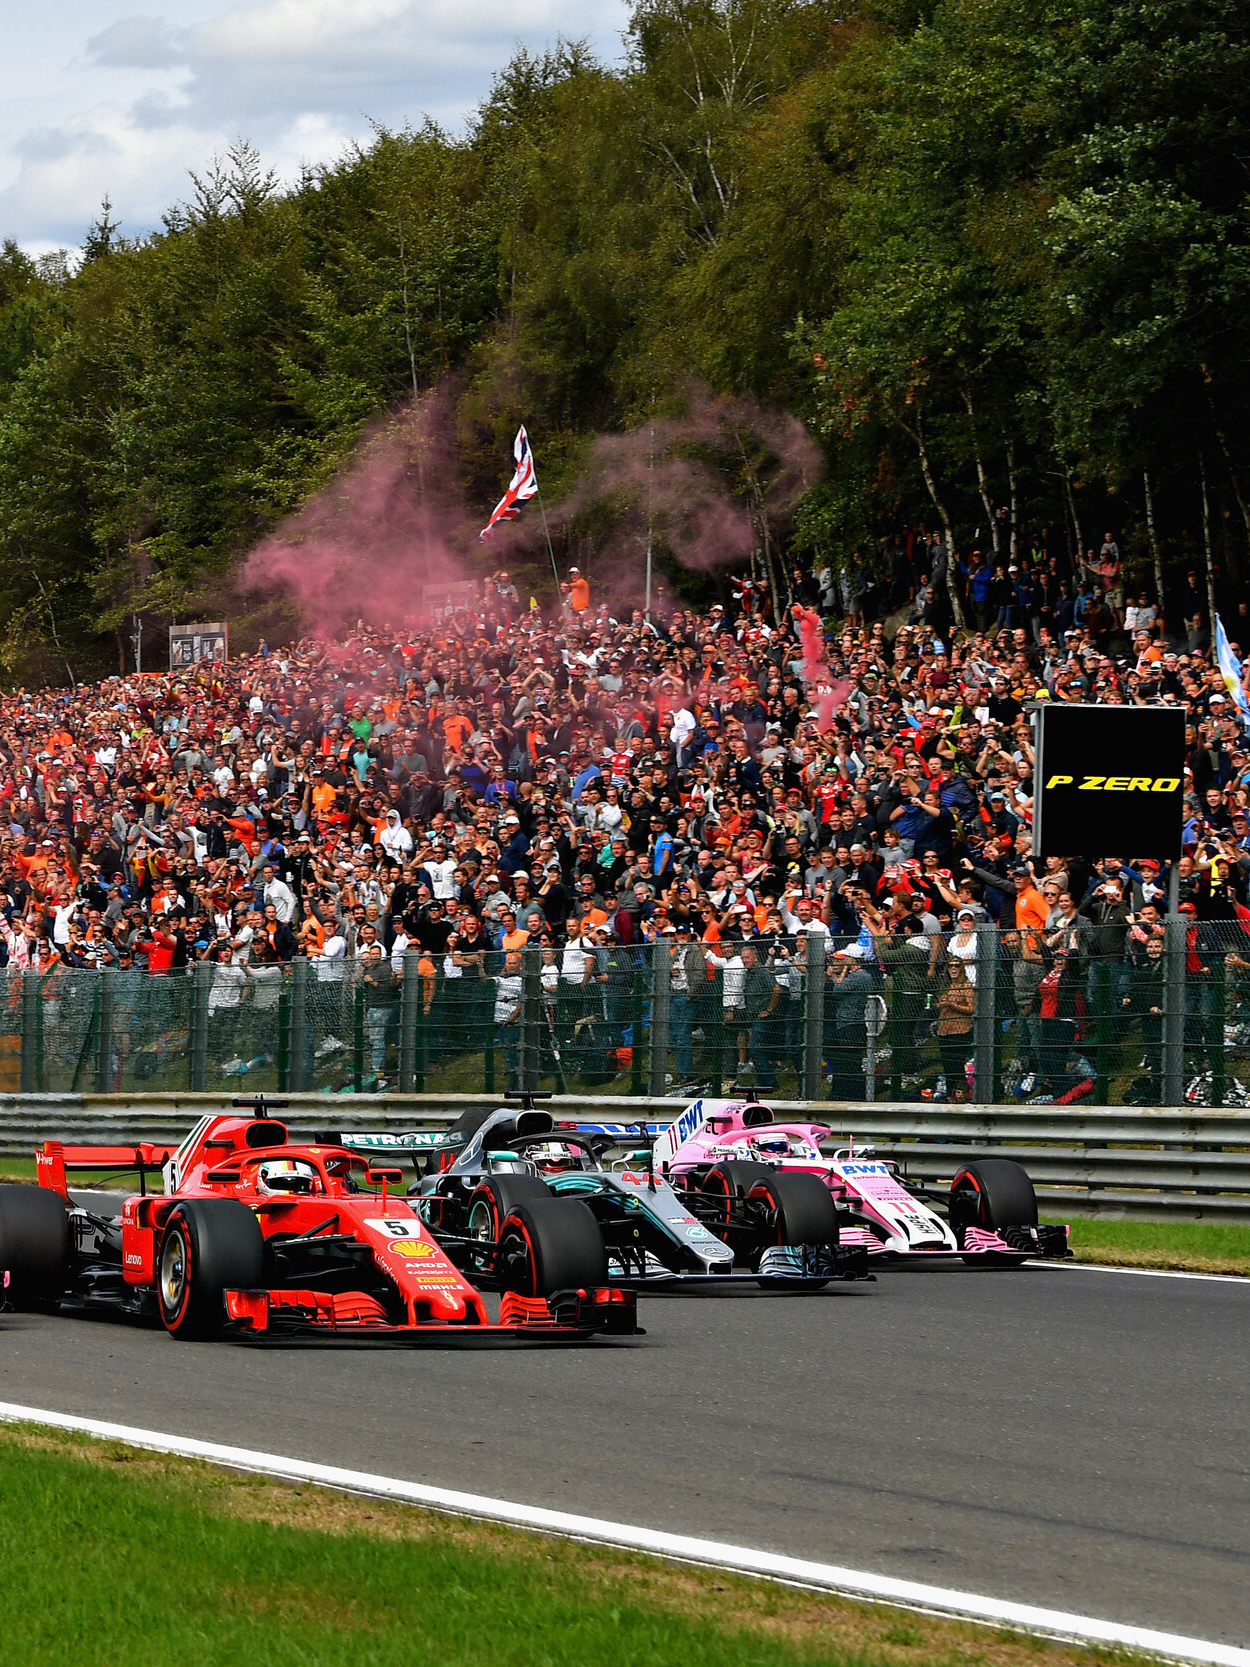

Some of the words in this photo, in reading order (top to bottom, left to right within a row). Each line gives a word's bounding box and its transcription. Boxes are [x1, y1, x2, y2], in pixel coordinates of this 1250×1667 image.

[1045, 775, 1074, 789] P
[1077, 776, 1181, 792] ZERO
[679, 1100, 704, 1144] BWT
[668, 1125, 678, 1155] 11
[842, 1165, 887, 1175] BWT
[170, 1163, 177, 1195] 5
[622, 1173, 662, 1186] 44
[888, 1202, 918, 1214] 11
[383, 1221, 410, 1236] 5
[903, 1214, 937, 1235] HYPE
[125, 1251, 142, 1266] Lenovo
